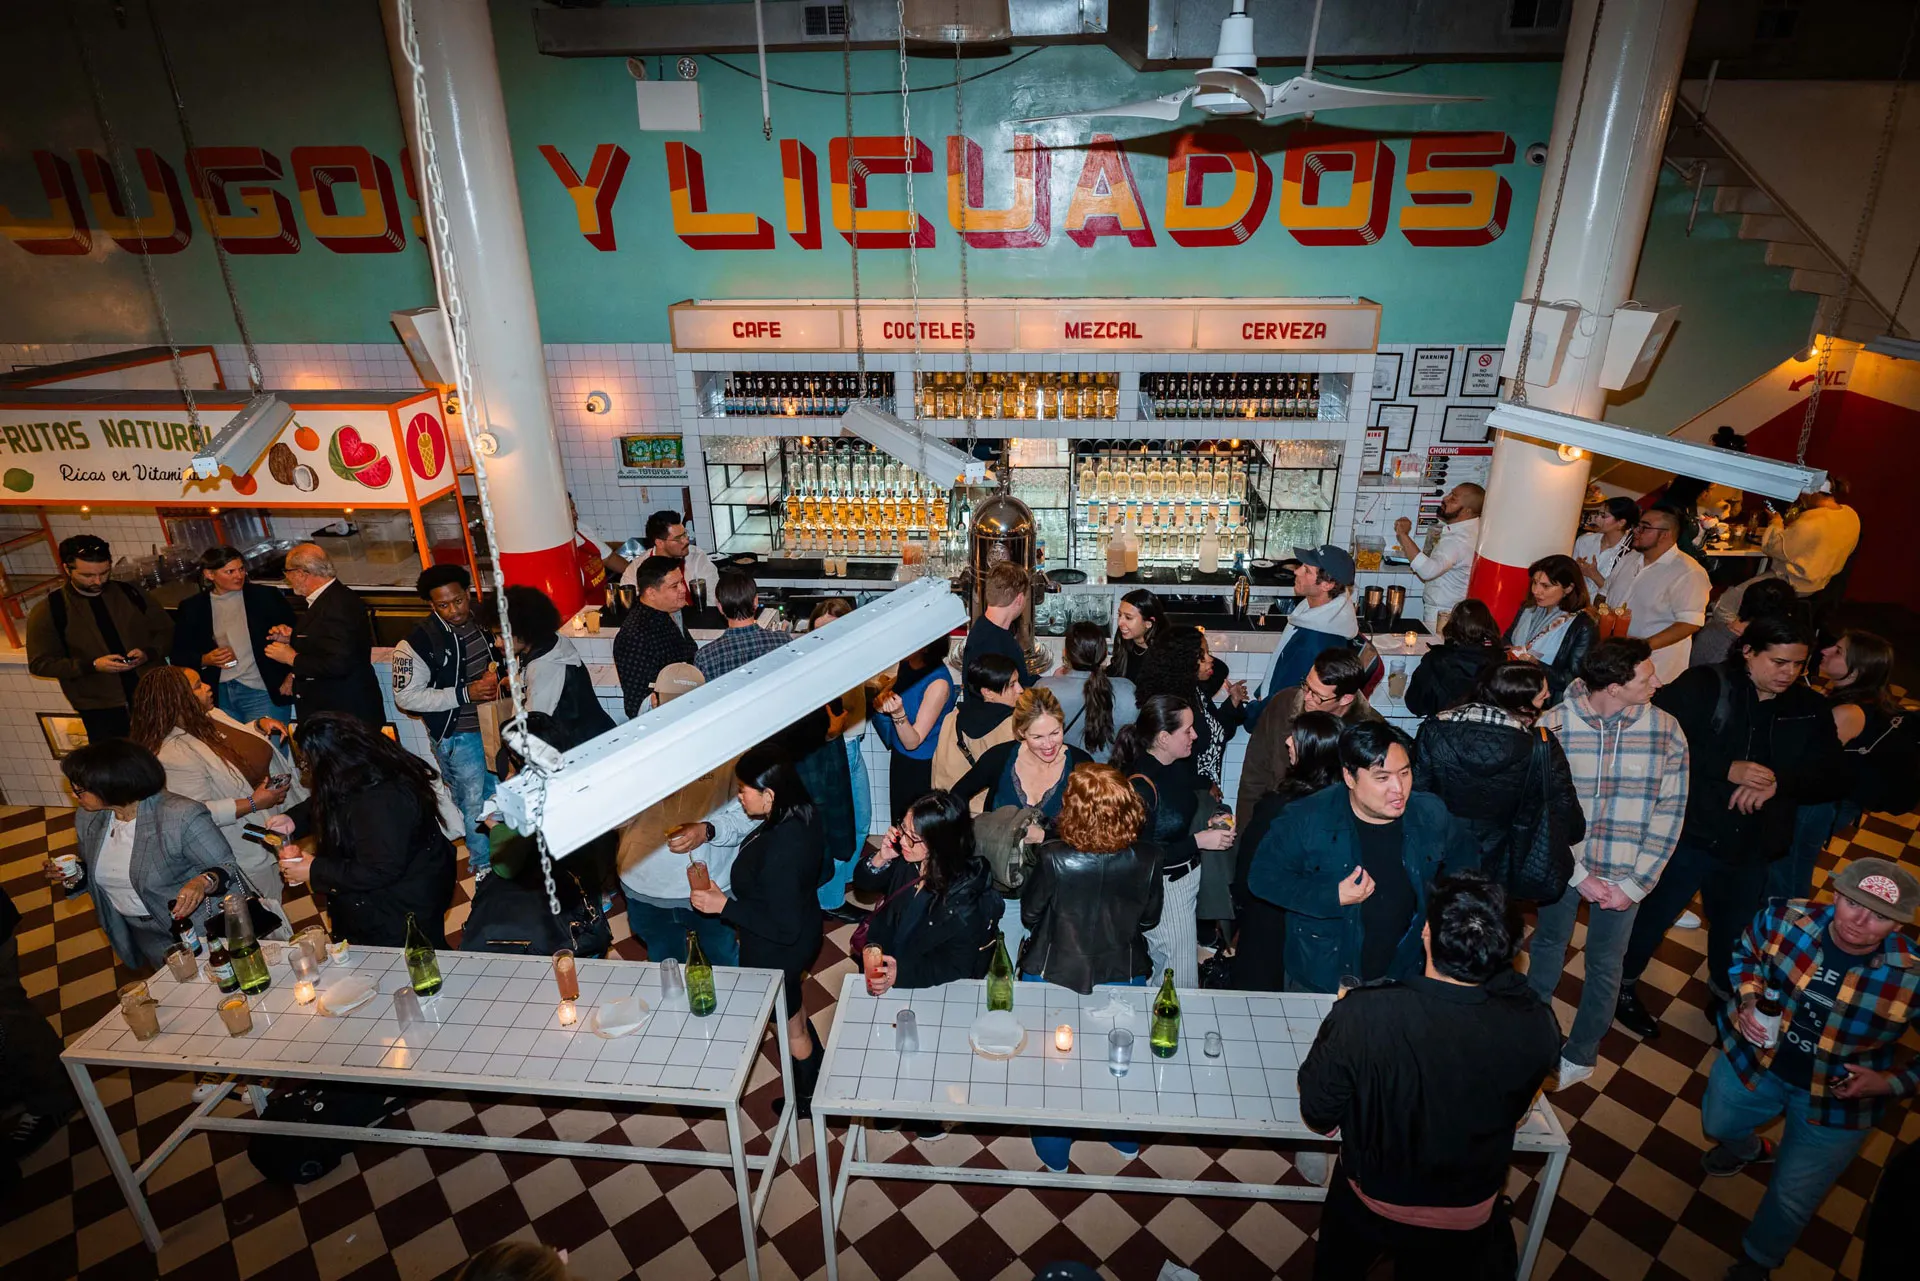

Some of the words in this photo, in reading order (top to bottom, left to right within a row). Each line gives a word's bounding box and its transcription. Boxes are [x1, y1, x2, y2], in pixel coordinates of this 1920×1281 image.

[0, 144, 426, 255] JUGO
[538, 143, 631, 252] Y
[665, 131, 1516, 251] LICUADOS
[733, 321, 781, 339] CAFE
[883, 321, 976, 340] COCTELES
[1064, 321, 1143, 340] MEZCAL
[1242, 322, 1327, 340] CERVEZA
[1429, 447, 1459, 455] CHOKING
[60, 464, 106, 482] Ricas
[112, 468, 131, 482] en
[132, 463, 204, 482] Vitami
